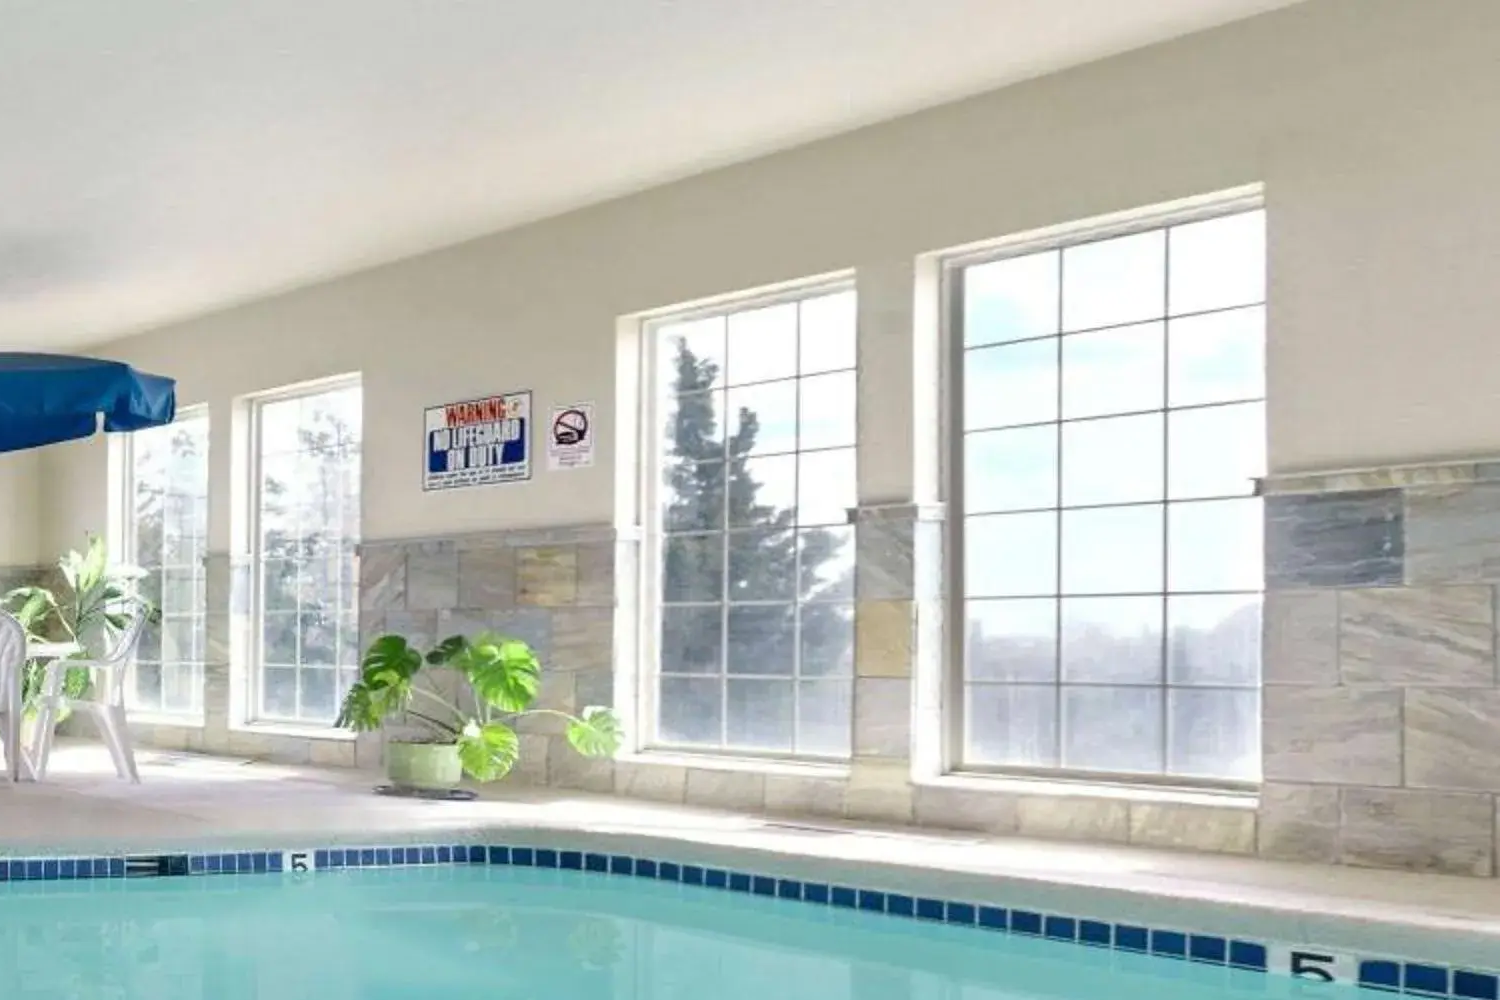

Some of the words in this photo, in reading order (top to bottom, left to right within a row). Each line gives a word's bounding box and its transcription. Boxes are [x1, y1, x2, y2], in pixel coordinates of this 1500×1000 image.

[444, 396, 507, 426] WARNING
[291, 853, 308, 872] 5
[1291, 951, 1334, 982] 5
